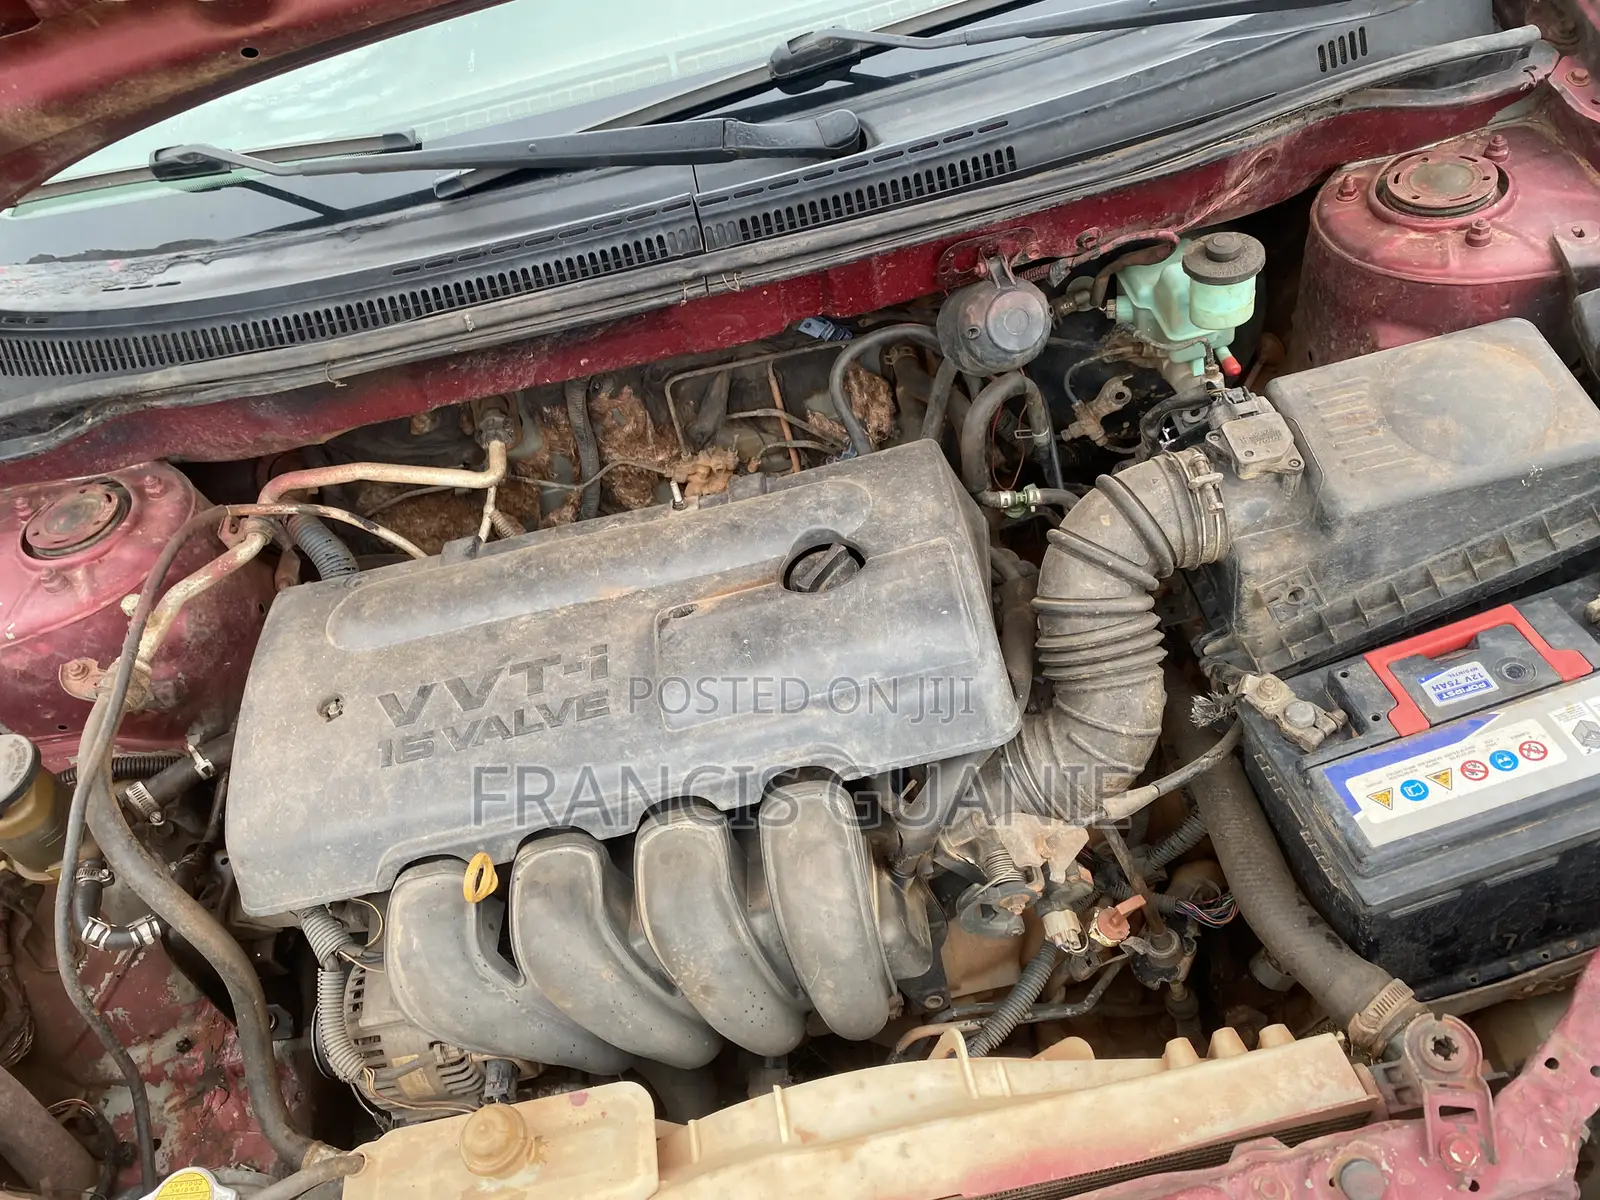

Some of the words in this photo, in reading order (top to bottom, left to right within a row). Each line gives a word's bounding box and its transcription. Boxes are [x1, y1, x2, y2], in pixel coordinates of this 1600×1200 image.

[1465, 672, 1485, 683] 12V
[1431, 678, 1462, 692] 75AH
[377, 729, 435, 769] 16
[441, 688, 611, 752] VALVE
